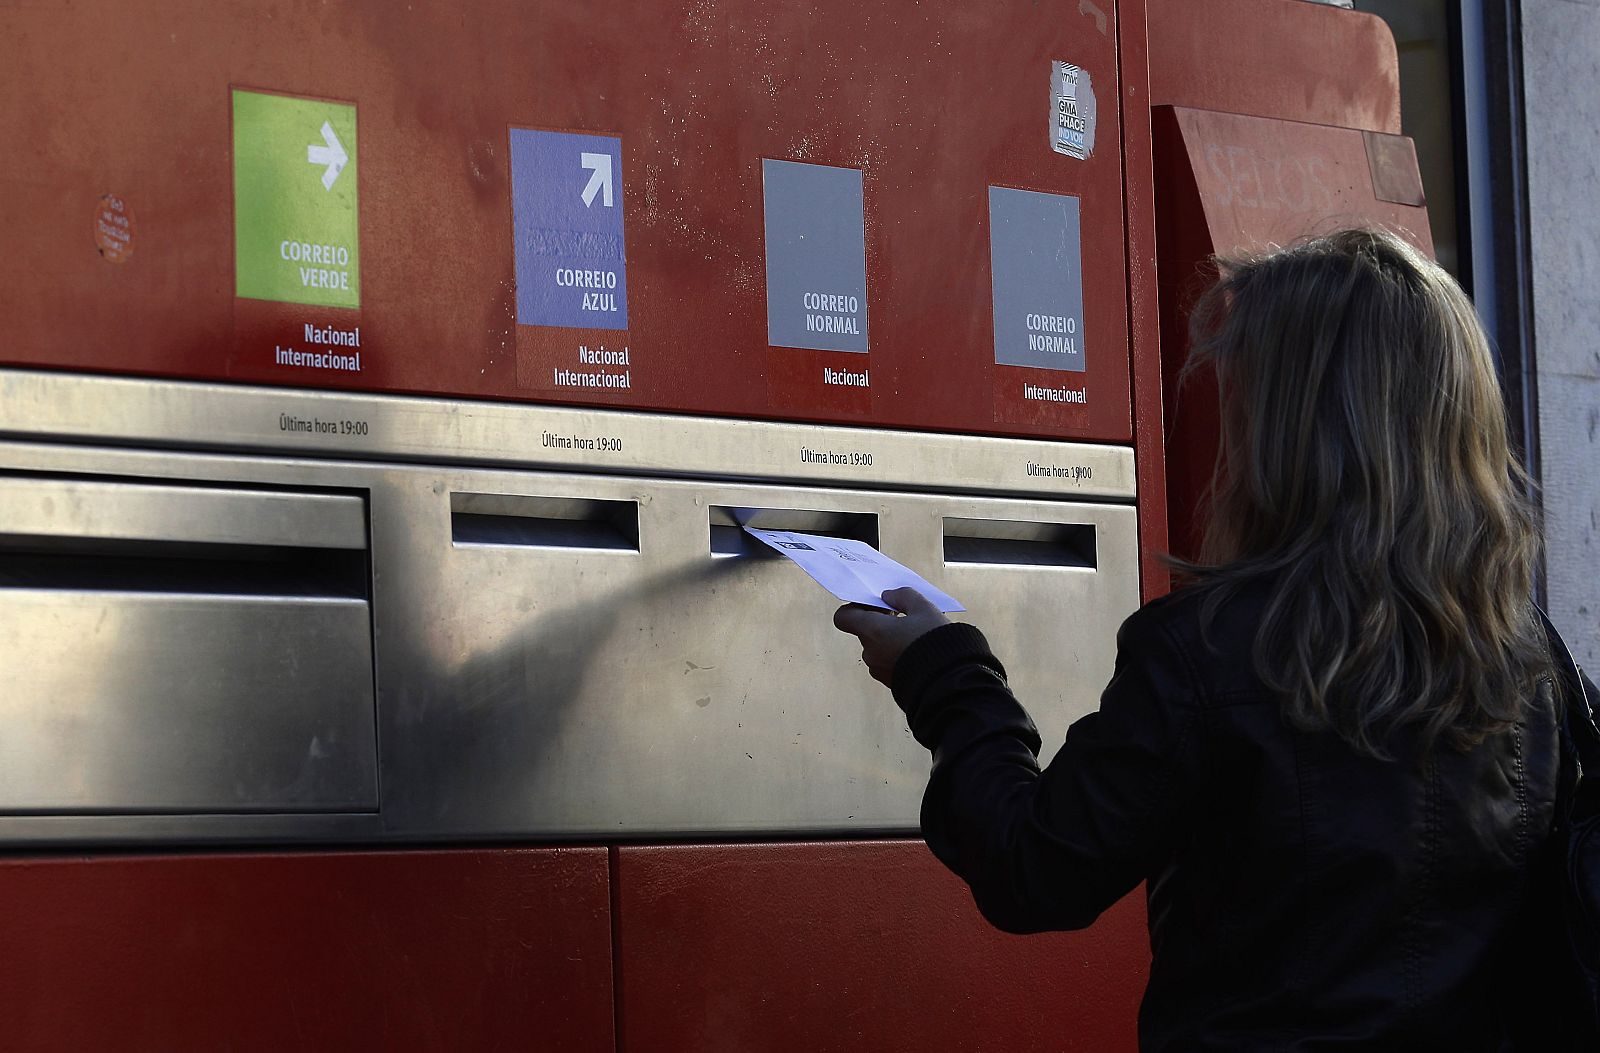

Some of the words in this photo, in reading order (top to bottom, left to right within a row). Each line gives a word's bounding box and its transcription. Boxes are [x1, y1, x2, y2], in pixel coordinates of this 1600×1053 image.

[1205, 143, 1333, 213] SELOS
[281, 240, 349, 267] CORREIO
[299, 266, 349, 290] VERDE
[556, 268, 617, 289] CORREIO
[582, 293, 618, 312] AZUL
[803, 292, 858, 313] CORREIO
[806, 314, 860, 335] NORMAL
[1026, 313, 1076, 334] CORREIO
[304, 323, 360, 347] Nacional
[1028, 334, 1077, 354] NORMAL
[275, 345, 361, 371] Internacional
[579, 345, 630, 366] Nacional
[554, 368, 631, 388] Internacional
[824, 367, 870, 387] Nacional
[1024, 382, 1087, 404] Internacional
[280, 412, 312, 432] Última
[314, 417, 337, 434] hora
[340, 420, 369, 435] 19:00
[541, 430, 571, 449] Última
[573, 434, 594, 450] hora
[596, 437, 622, 452] 19:00
[800, 446, 827, 463] Última
[829, 450, 847, 465] hora
[849, 452, 873, 466] 19:00
[1026, 460, 1051, 477] Última
[1052, 464, 1069, 478] hora
